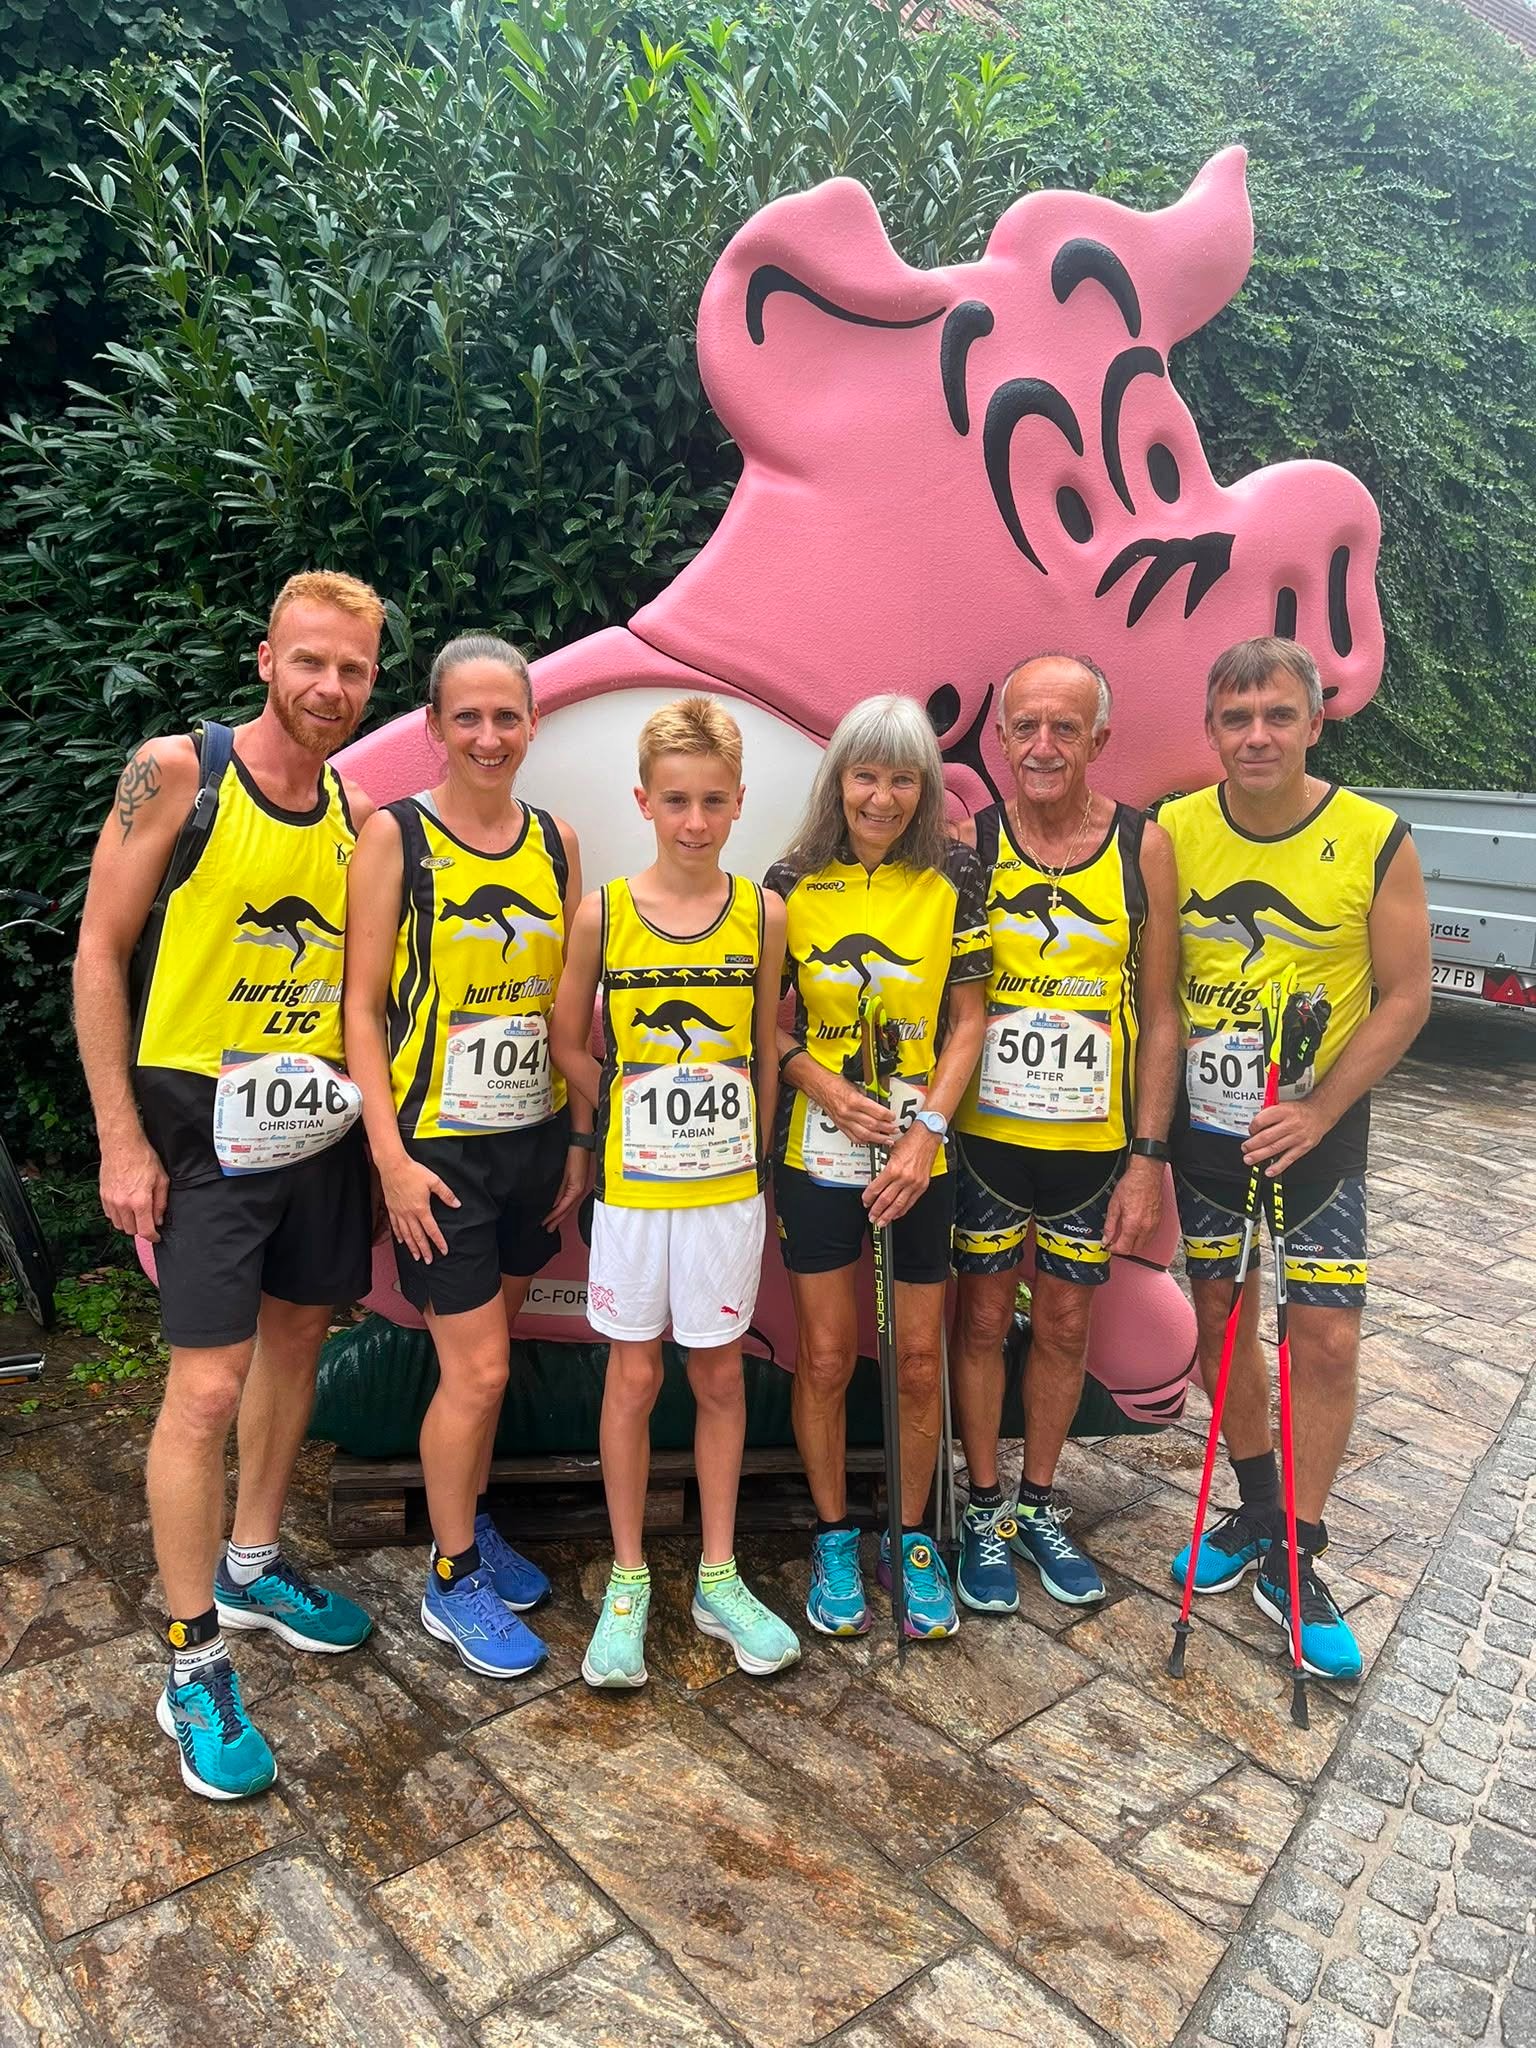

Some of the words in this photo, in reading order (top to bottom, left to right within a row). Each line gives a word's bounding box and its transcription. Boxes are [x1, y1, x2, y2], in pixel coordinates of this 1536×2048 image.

[1453, 969, 1475, 988] FB
[262, 1010, 321, 1034] LTC
[997, 1028, 1098, 1070] 5014
[1026, 1070, 1064, 1081] PETER
[1198, 1051, 1265, 1088] 501
[487, 1079, 539, 1089] CORNELIA
[1222, 1090, 1265, 1101] MICHAE
[237, 1077, 349, 1118] 1046
[640, 1082, 740, 1126] 1048
[259, 1119, 324, 1131] CHRISTIAN
[672, 1127, 715, 1138] FABIAN
[1244, 1166, 1260, 1213] LEKI
[1273, 1182, 1285, 1230] LEKI
